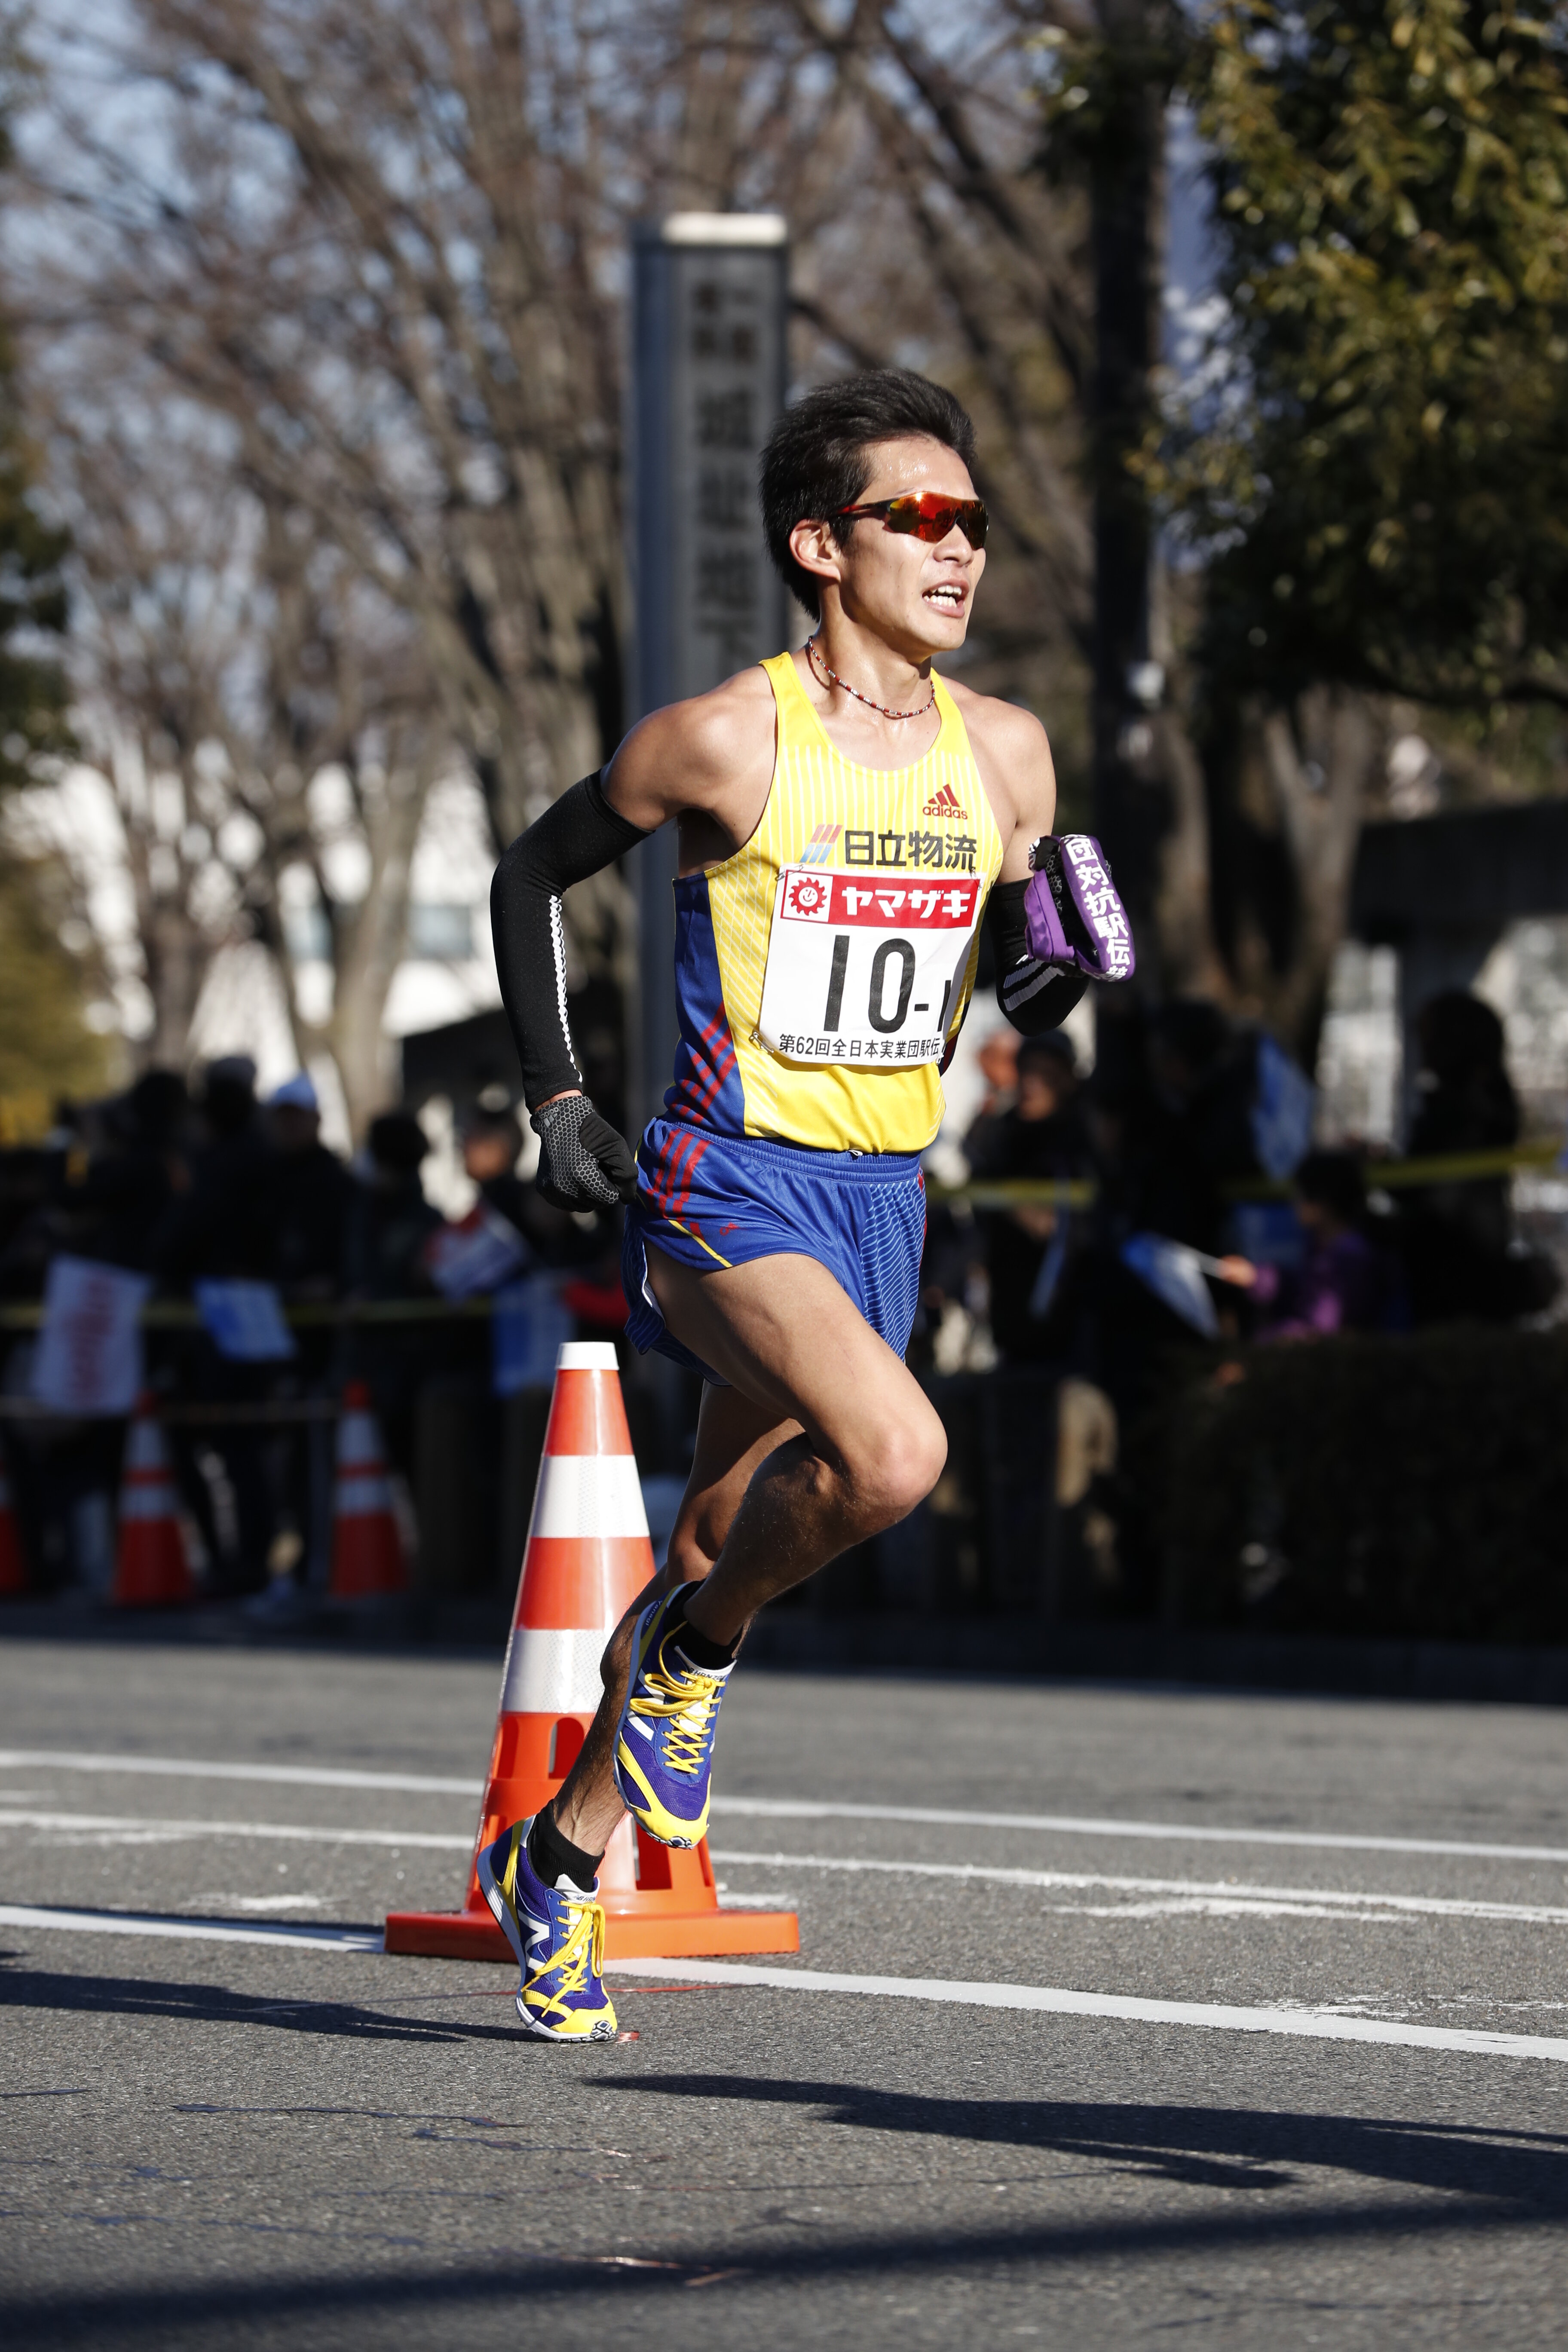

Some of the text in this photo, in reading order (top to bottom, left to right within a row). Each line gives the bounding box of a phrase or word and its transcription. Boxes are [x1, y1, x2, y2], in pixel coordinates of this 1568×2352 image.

[922, 805, 968, 820] adidas
[845, 830, 977, 870] 日立物流
[842, 886, 971, 918] ヤマザキ
[779, 1033, 940, 1059] 第62回全日本実業団駅伝
